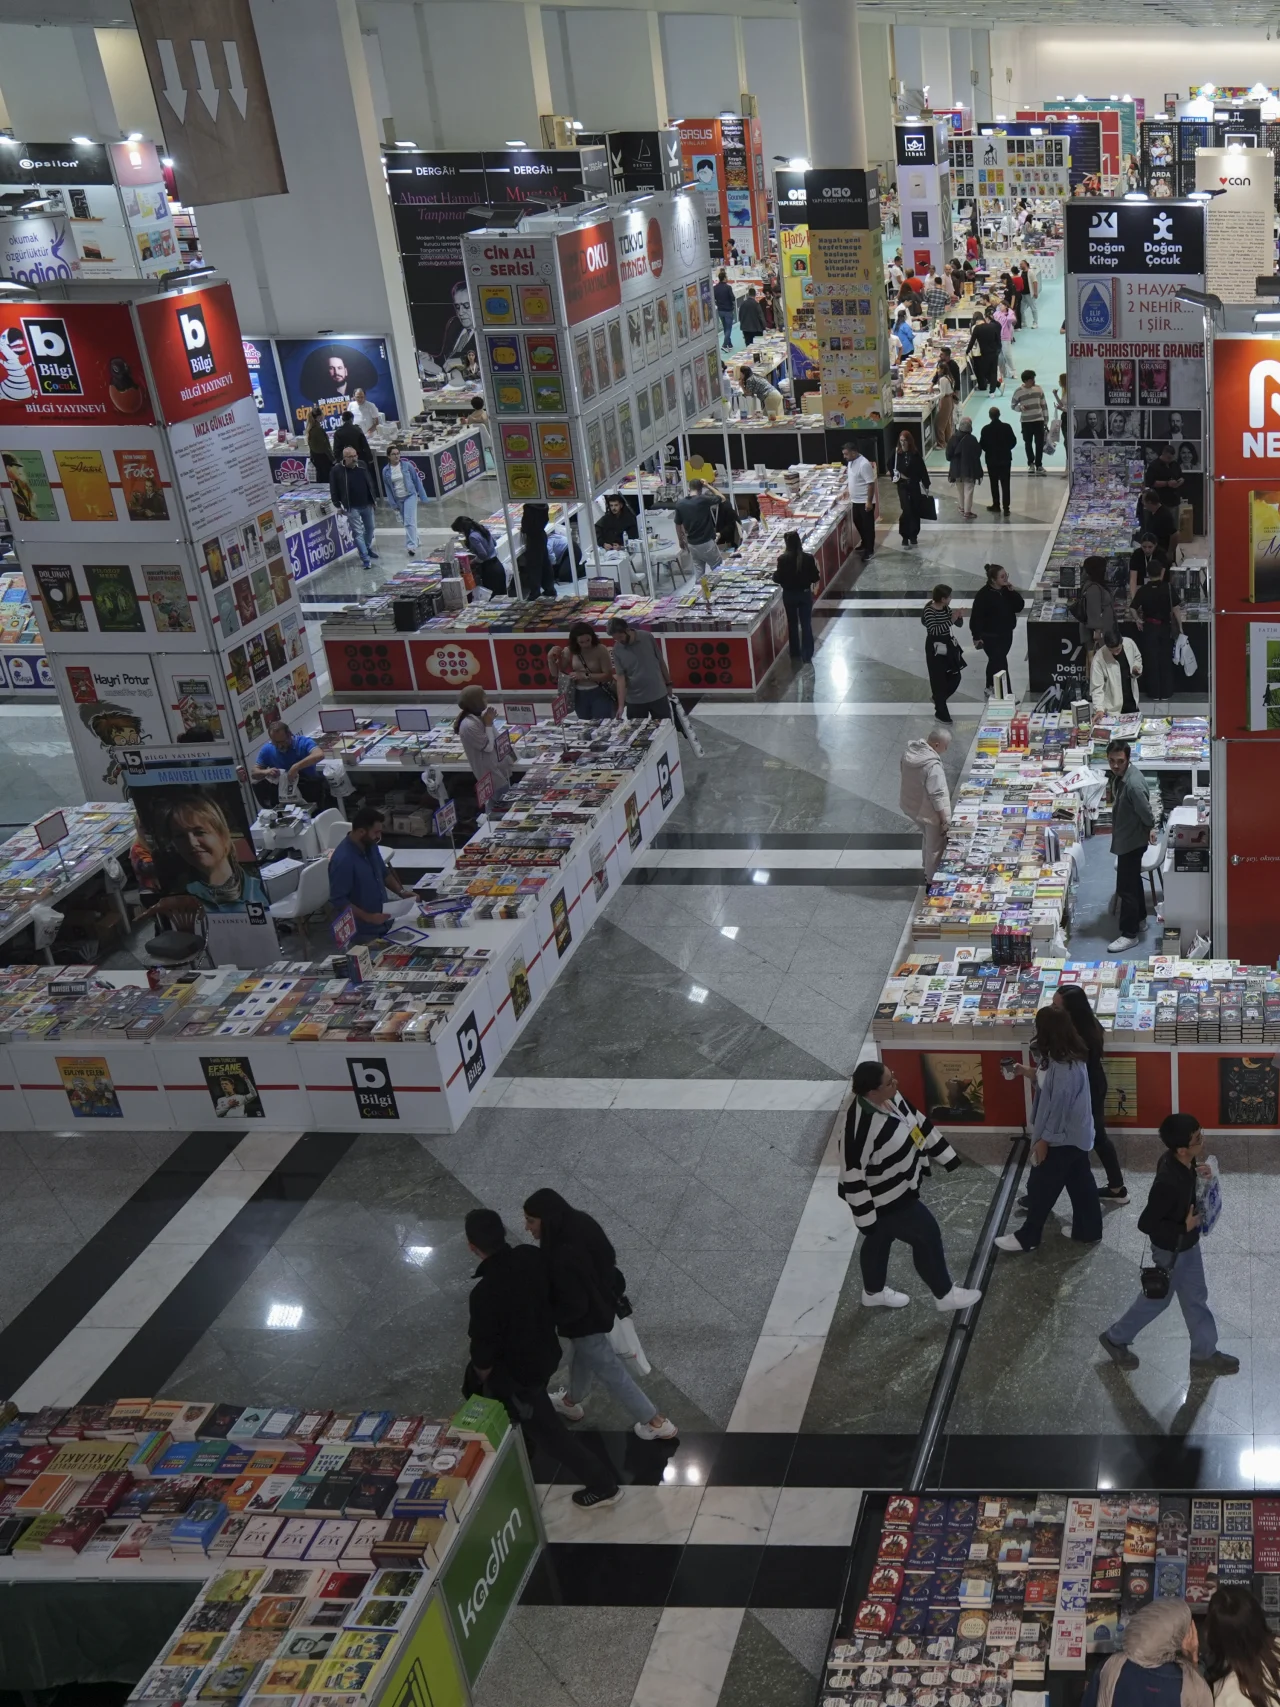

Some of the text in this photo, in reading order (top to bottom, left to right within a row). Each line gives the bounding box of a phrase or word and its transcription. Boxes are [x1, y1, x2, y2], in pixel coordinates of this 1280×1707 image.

[416, 166, 455, 175] DERGÂH
[514, 165, 553, 174] DERGÂH
[1229, 177, 1251, 186] can
[400, 192, 480, 204] Ahmet Hamdi
[9, 233, 38, 245] okumak
[619, 231, 644, 253] TOKYO
[783, 230, 807, 249] Harry
[6, 247, 49, 262] özgürlüktür
[484, 244, 536, 260] CİN ALİ
[1089, 243, 1125, 254] Doğan
[1144, 242, 1182, 254] Doğan
[1089, 256, 1118, 267] Kitap
[1146, 255, 1181, 267] Çocuk
[490, 262, 535, 276] SERİSİ
[620, 255, 648, 282] MANGA
[1127, 284, 1133, 295] 3
[1128, 300, 1194, 313] 2 NEHİR...
[1139, 319, 1143, 330] 1
[1069, 343, 1160, 358] JEAN-CHRISTOPHE
[190, 354, 213, 373] Bilgi
[40, 364, 73, 379] Bilgi
[44, 381, 77, 392] Çocuk
[181, 384, 200, 401] BİLGİ
[199, 374, 233, 395] YAYINEVİ
[25, 403, 106, 413] BİLGİ YAYINEVİ
[211, 410, 236, 433] GÜNLERİ
[124, 464, 155, 479] Foks
[275, 468, 306, 480] Pemb
[309, 540, 335, 564] indigo
[39, 571, 71, 579] DOLUNAY
[1057, 664, 1086, 674] Doğan
[94, 673, 150, 687] Hayri Potur
[172, 752, 210, 760] YAYINEVİ
[158, 767, 233, 782] MAVİSEL YENER
[208, 1063, 242, 1072] EFSANE
[467, 1057, 484, 1085] Bilgi
[360, 1093, 392, 1106] Bilgi
[457, 1506, 523, 1639] kadim
